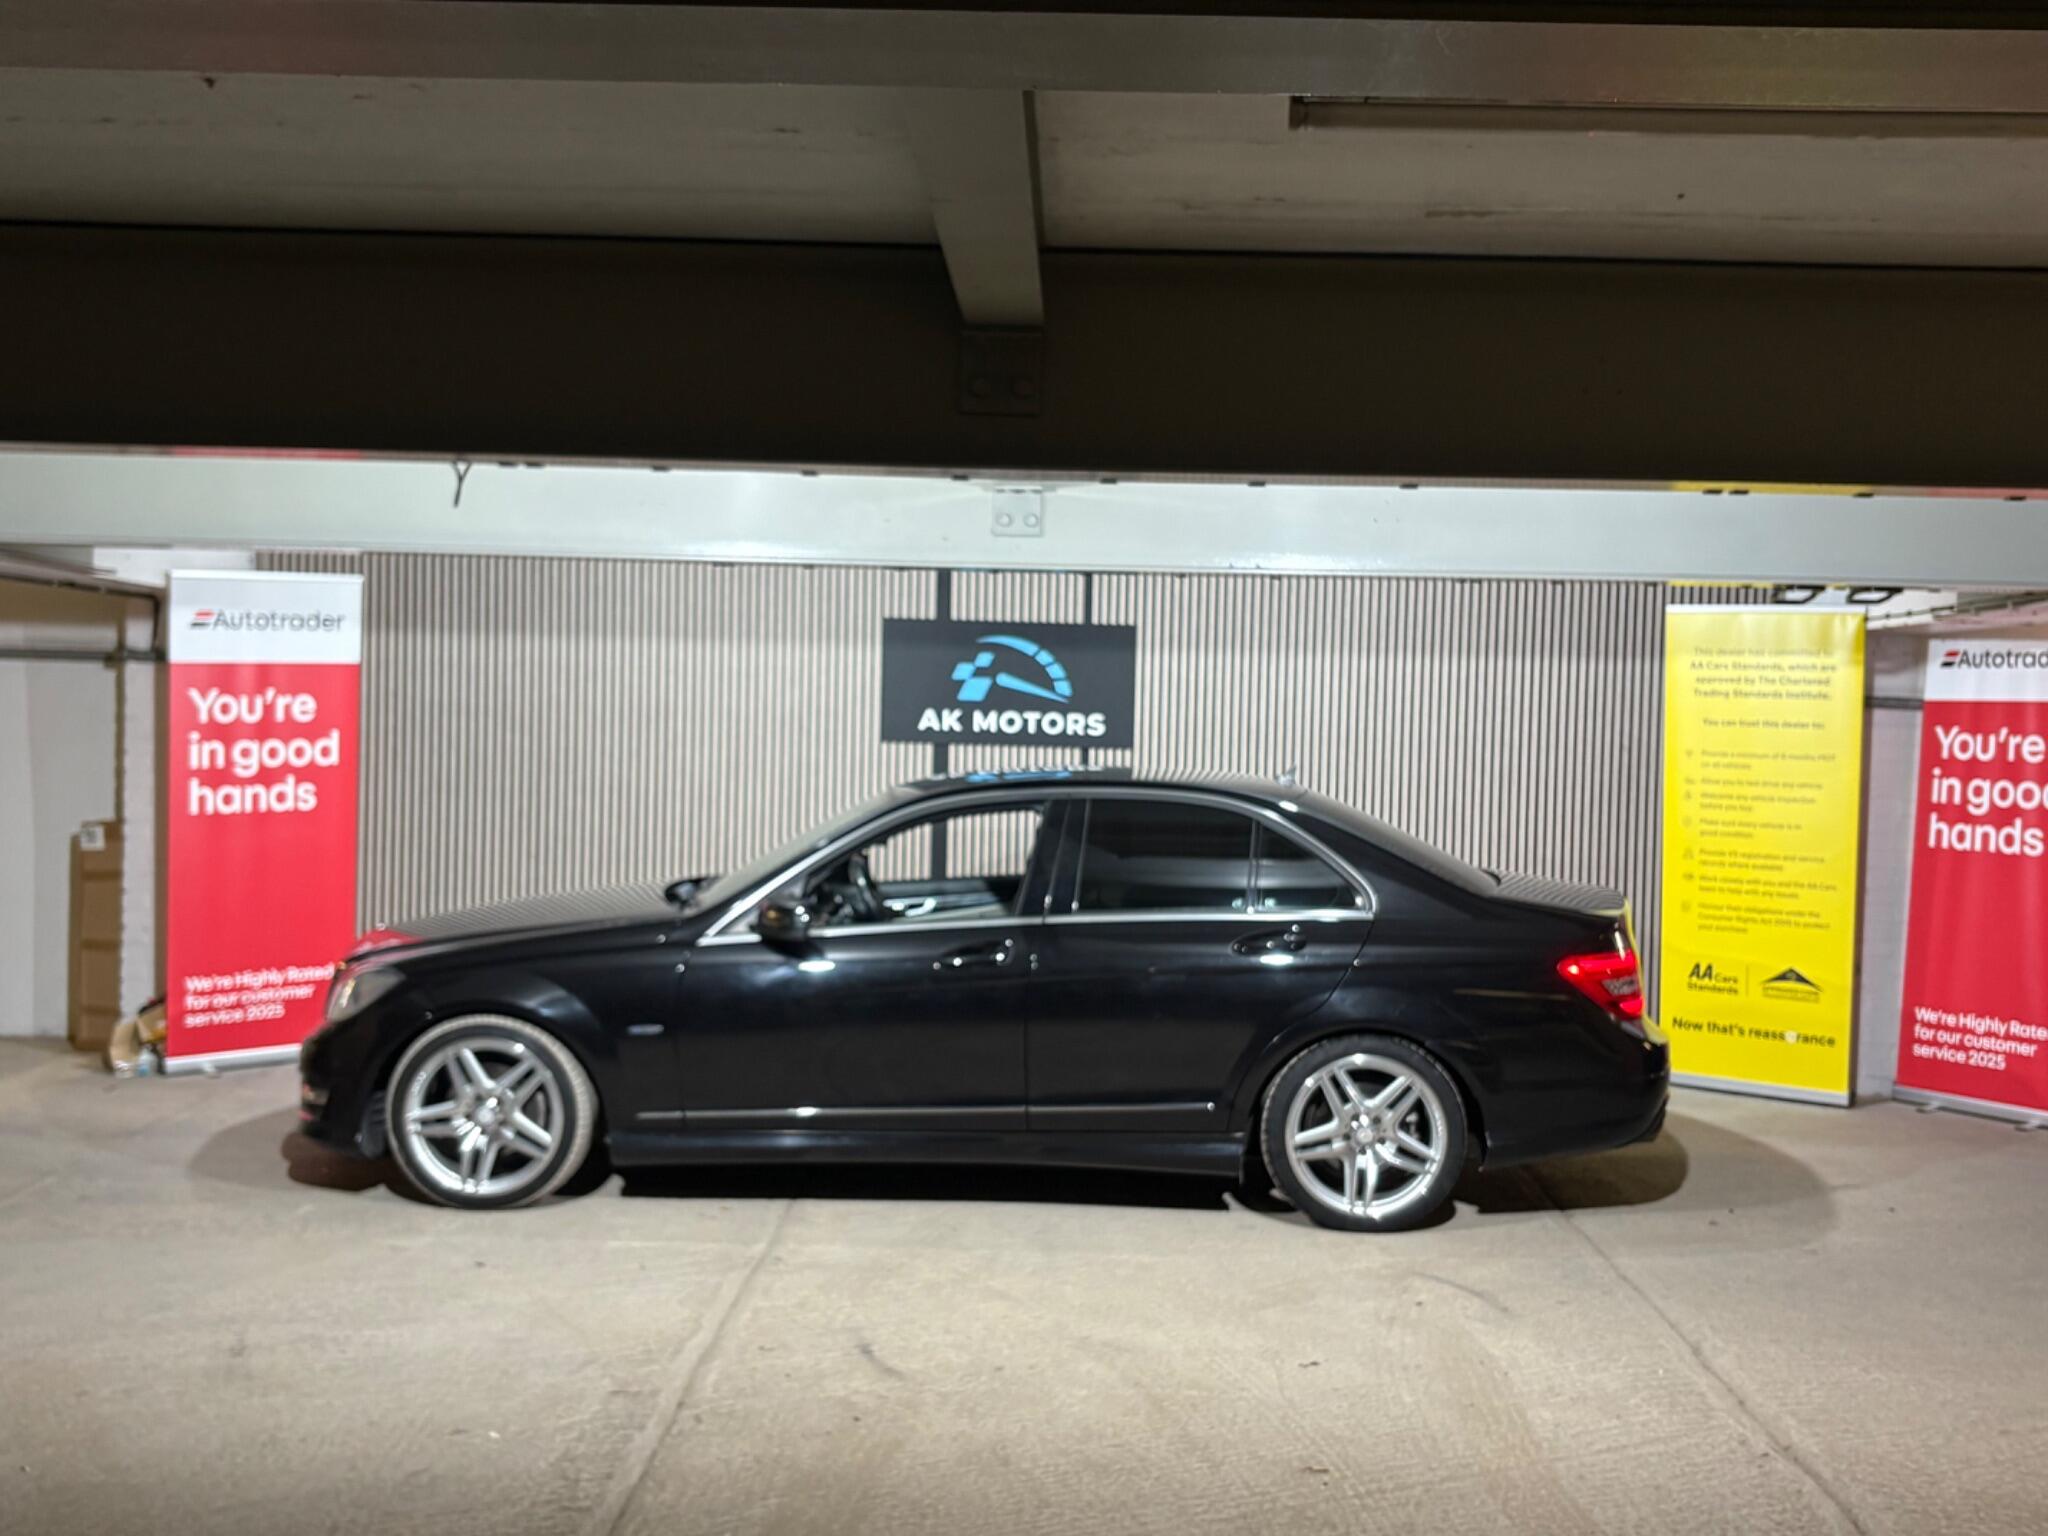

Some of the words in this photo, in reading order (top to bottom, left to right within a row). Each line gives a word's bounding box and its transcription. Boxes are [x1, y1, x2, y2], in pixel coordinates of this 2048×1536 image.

[213, 610, 345, 631] Autotrader
[187, 687, 317, 723] You're
[917, 708, 963, 732] AK
[972, 709, 1106, 736] MOTORS
[188, 731, 225, 769] in
[232, 729, 340, 777] good
[1935, 725, 2045, 763] You're
[188, 774, 317, 816] hands
[1931, 767, 1961, 805] in
[1967, 777, 2048, 816] goo
[1928, 812, 2045, 857] hands
[235, 968, 285, 989] Highly
[1689, 962, 1712, 980] AA
[185, 993, 209, 1010] for
[212, 992, 240, 1007] our
[241, 983, 316, 1002] customer
[1688, 983, 1738, 996] Standards
[184, 1008, 244, 1028] service
[246, 1002, 285, 1021] 2025
[1959, 1012, 2008, 1037] Highly
[1672, 1017, 1702, 1031] Now
[1748, 1028, 1836, 1048] reassrance
[1914, 1023, 1935, 1041] for
[1937, 1029, 1962, 1045] our
[1964, 1034, 2038, 1057] customer
[1912, 1043, 1966, 1064] service
[1968, 1049, 2006, 1071] 2025
